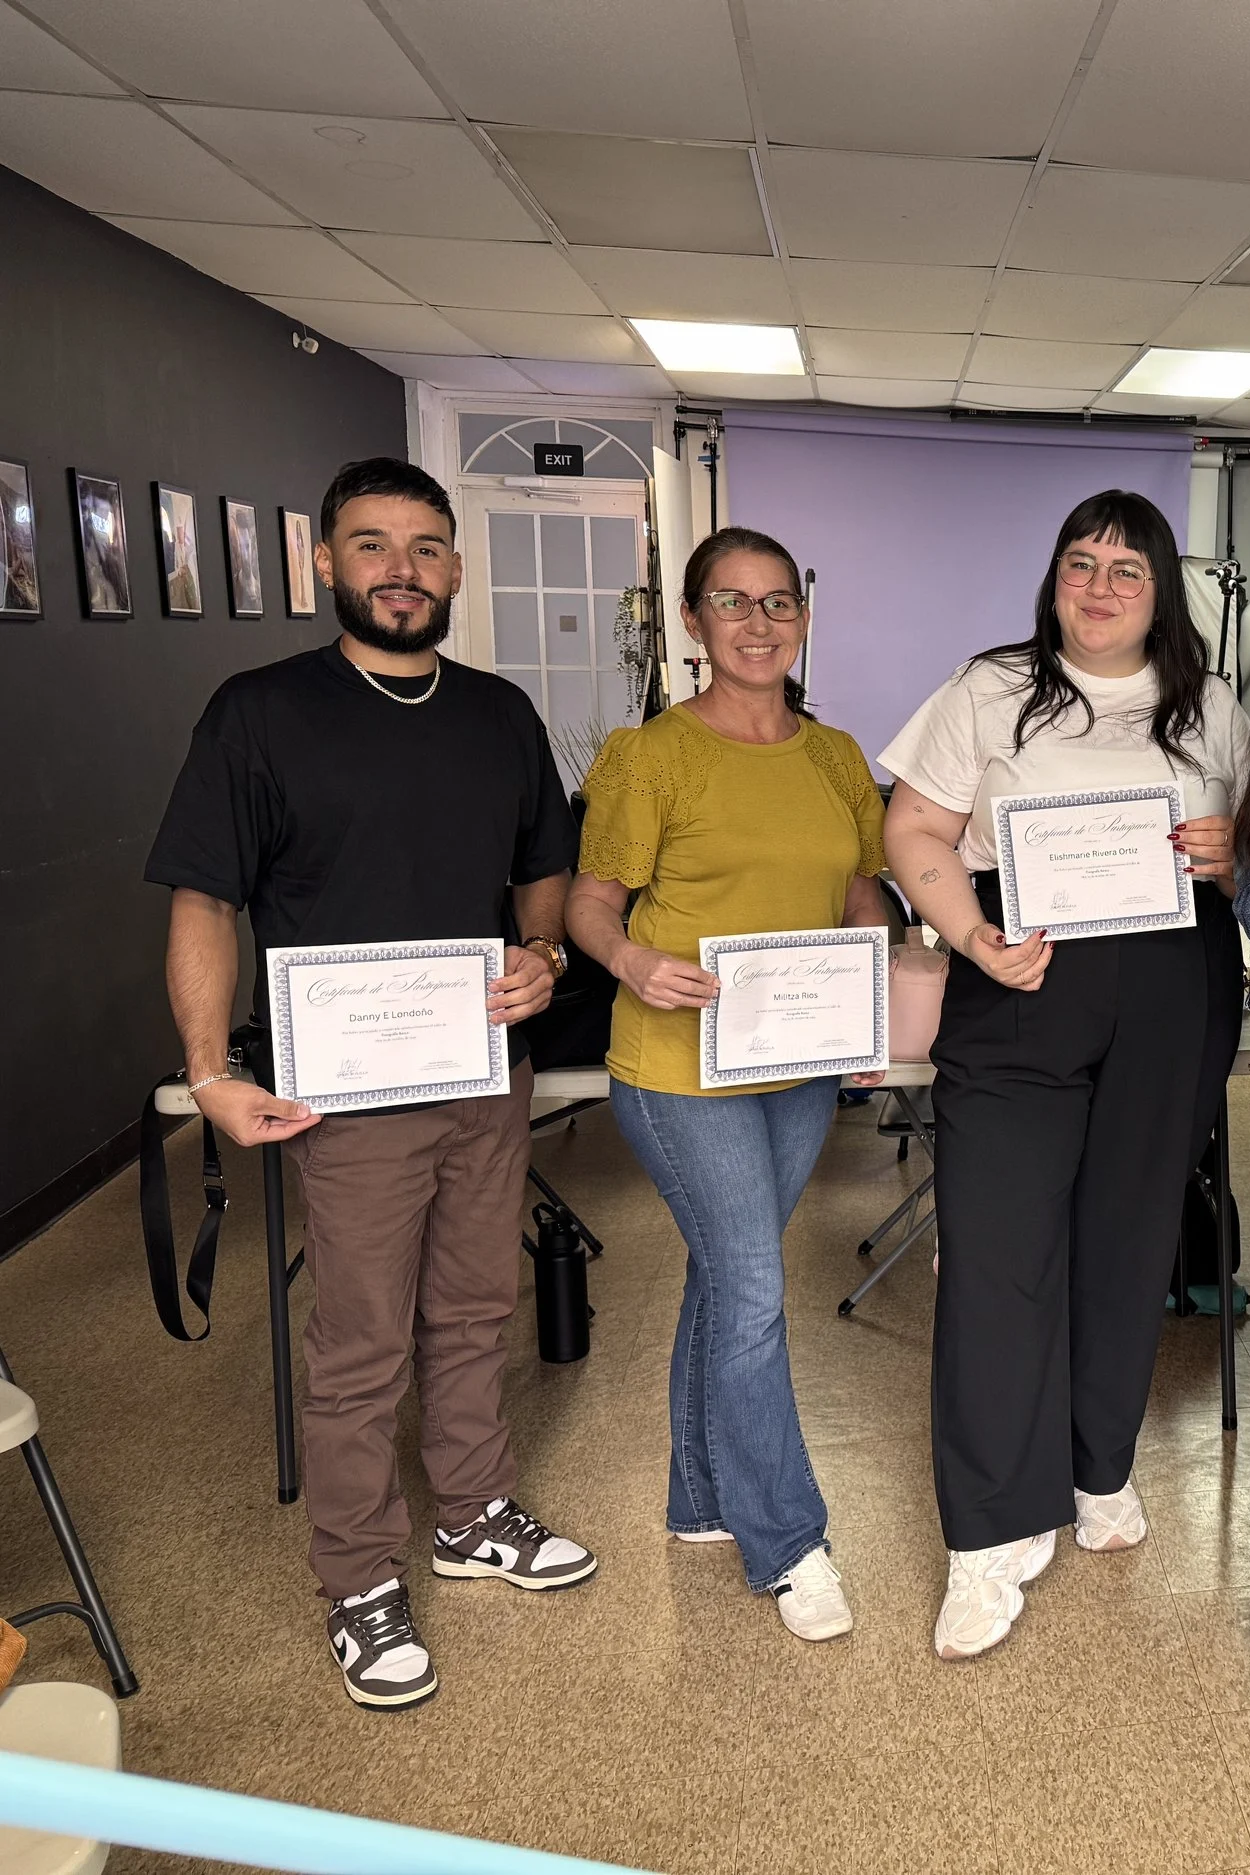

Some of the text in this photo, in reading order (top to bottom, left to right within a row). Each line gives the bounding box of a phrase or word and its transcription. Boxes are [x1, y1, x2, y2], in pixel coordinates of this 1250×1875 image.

[545, 454, 572, 465] EXIT
[1118, 847, 1138, 855] Ortiz
[349, 1008, 434, 1022] Danny E Londoño
